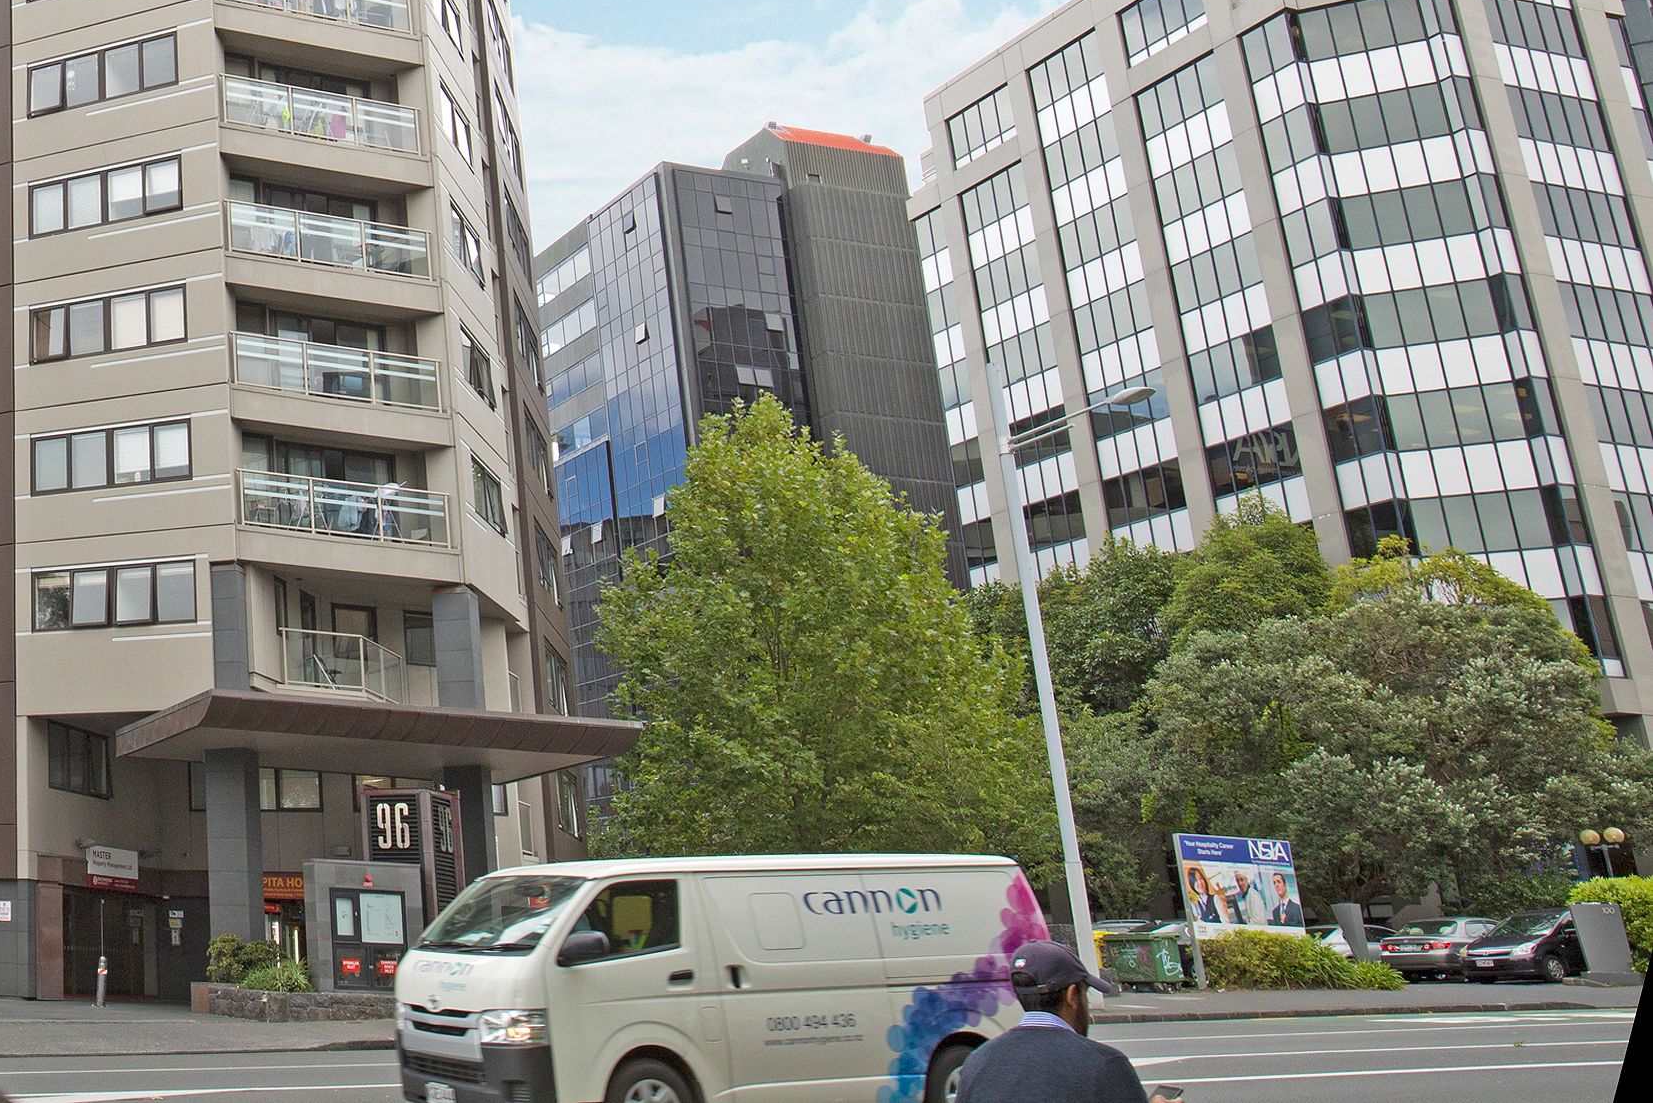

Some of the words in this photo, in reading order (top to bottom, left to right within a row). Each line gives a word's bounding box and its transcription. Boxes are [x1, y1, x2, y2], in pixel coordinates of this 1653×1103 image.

[376, 802, 411, 849] 96
[437, 805, 454, 853] 96
[92, 850, 112, 860] MASTER
[262, 877, 284, 887] PITA
[803, 887, 943, 916] cannon
[1601, 906, 1616, 915] 100
[890, 921, 950, 940] hygiene
[766, 1016, 800, 1032] 0800
